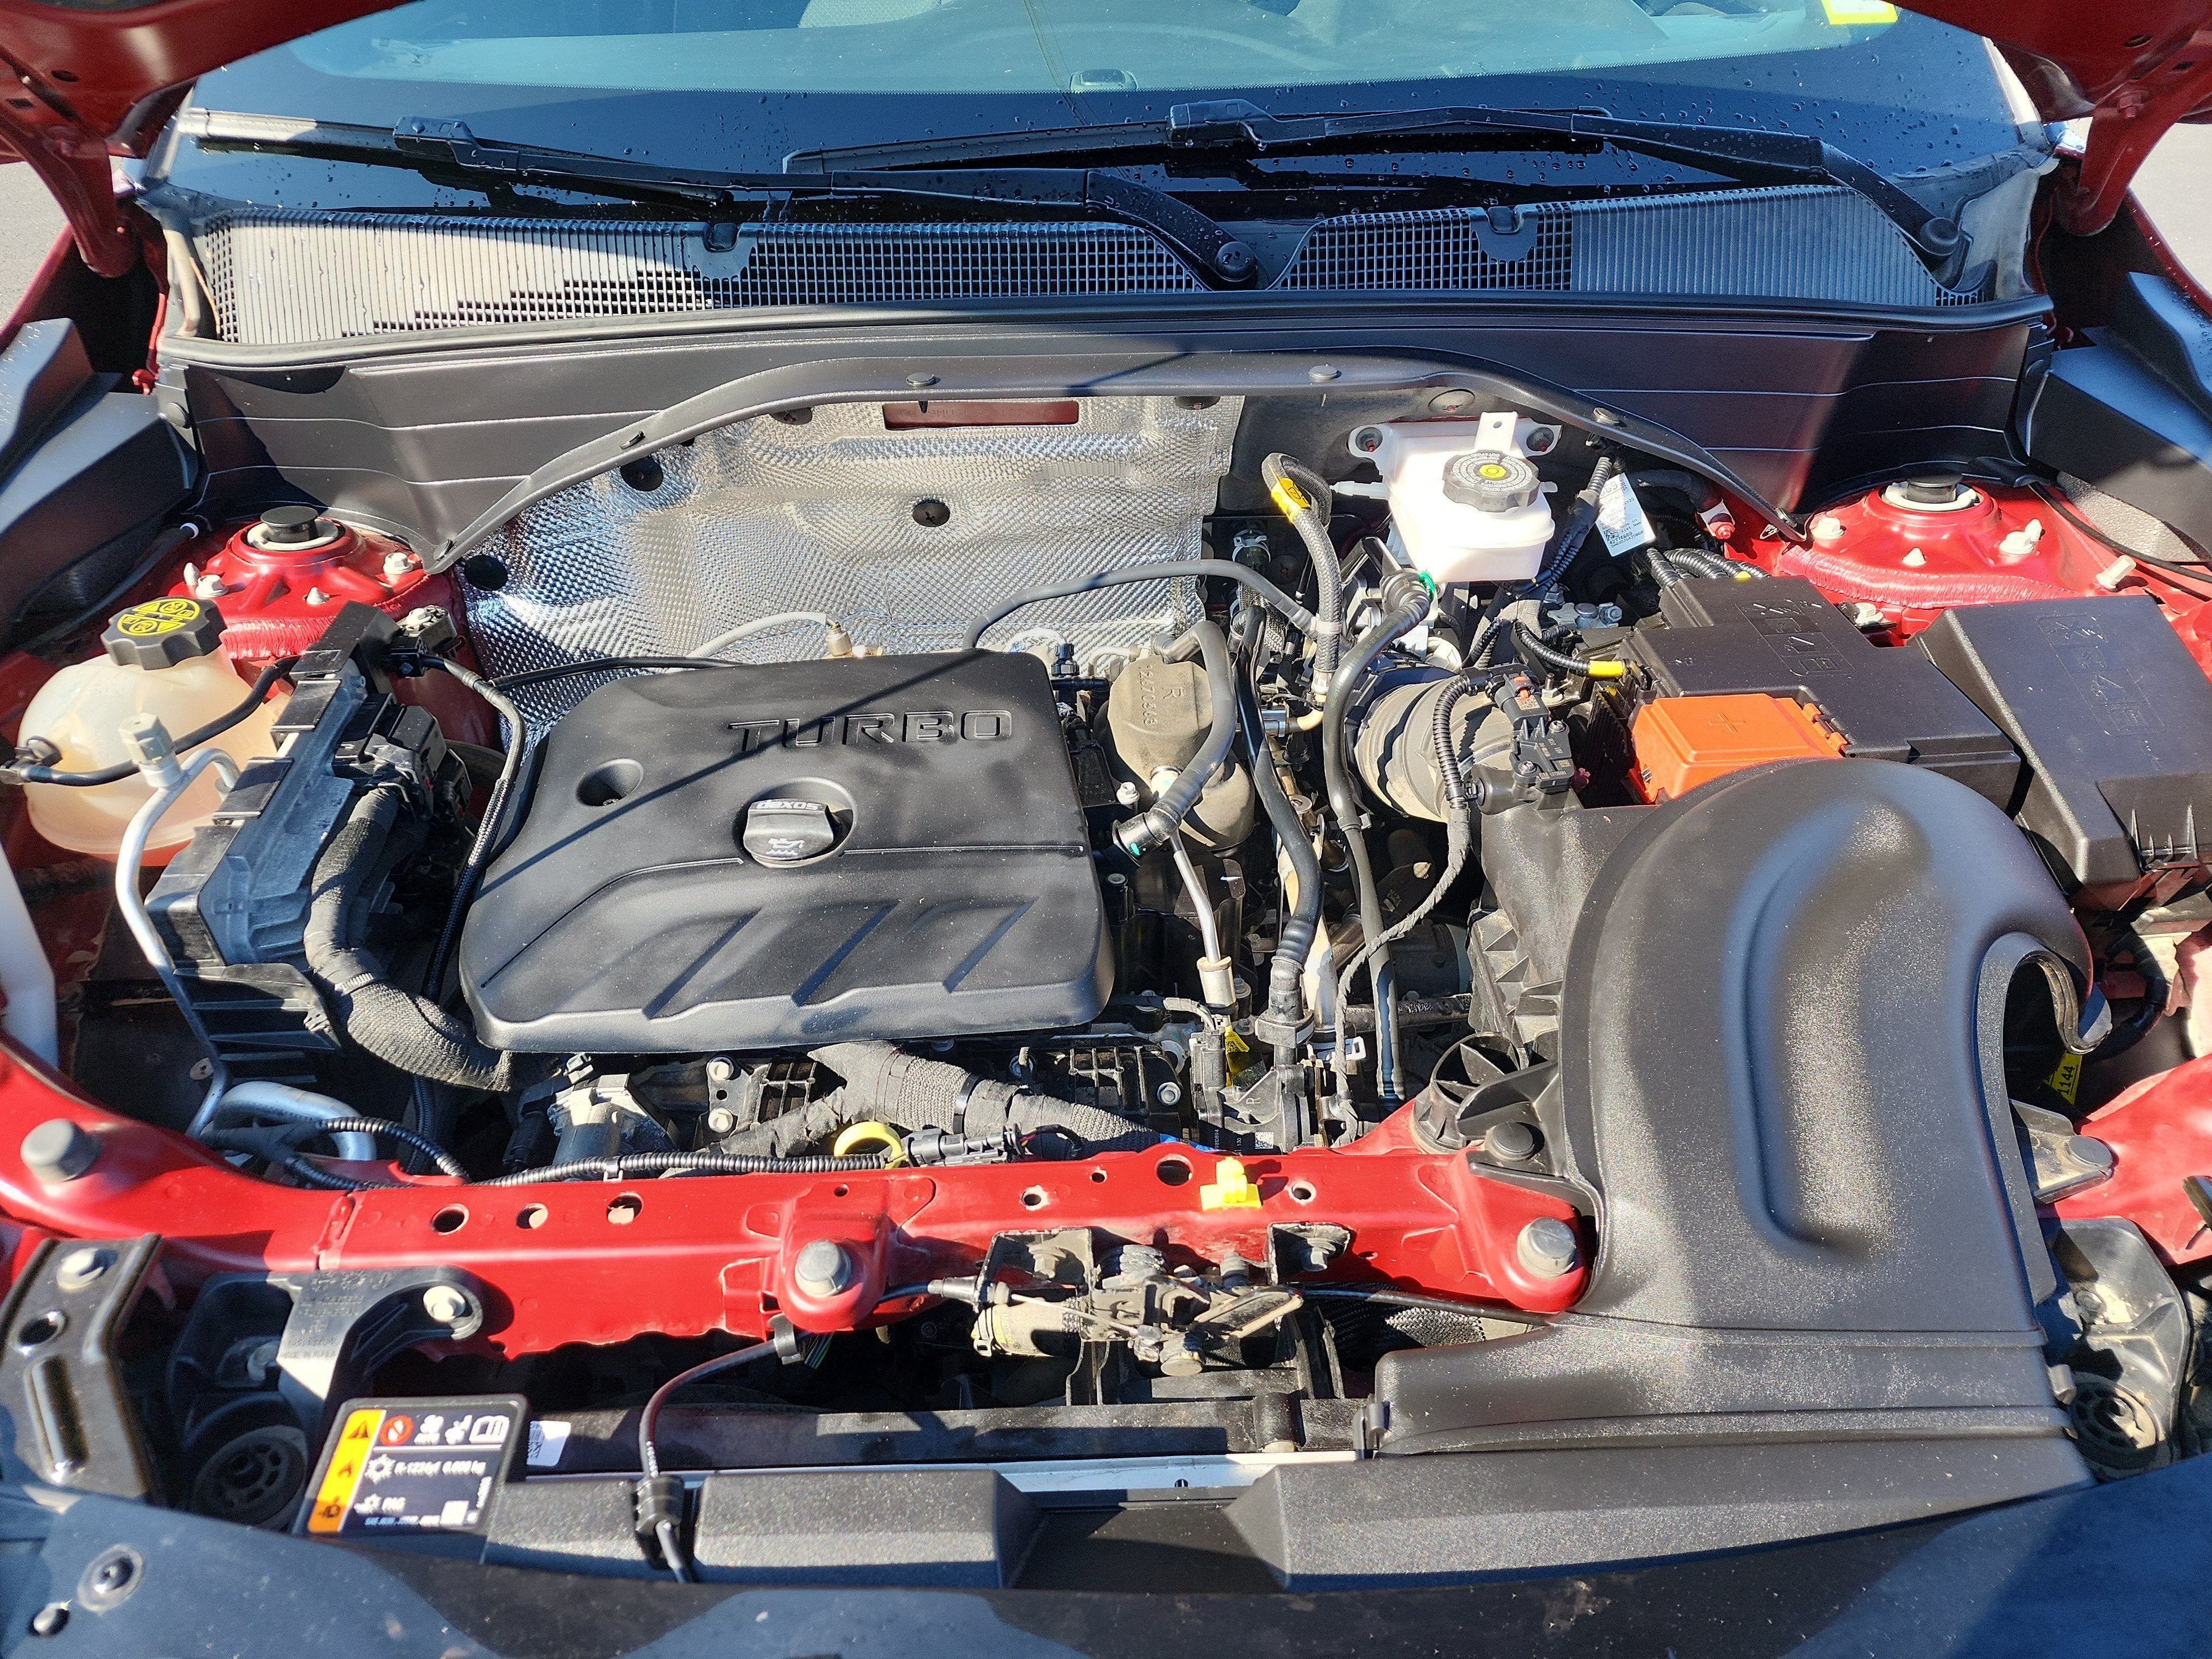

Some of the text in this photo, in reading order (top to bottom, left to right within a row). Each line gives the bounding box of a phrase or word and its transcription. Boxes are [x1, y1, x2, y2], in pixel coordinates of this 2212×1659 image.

[1138, 664, 1158, 726] 12670563
[1162, 686, 1182, 700] R
[728, 710, 1013, 751] TURBO
[757, 799, 822, 811] dexos
[2057, 1065, 2075, 1095] 1144
